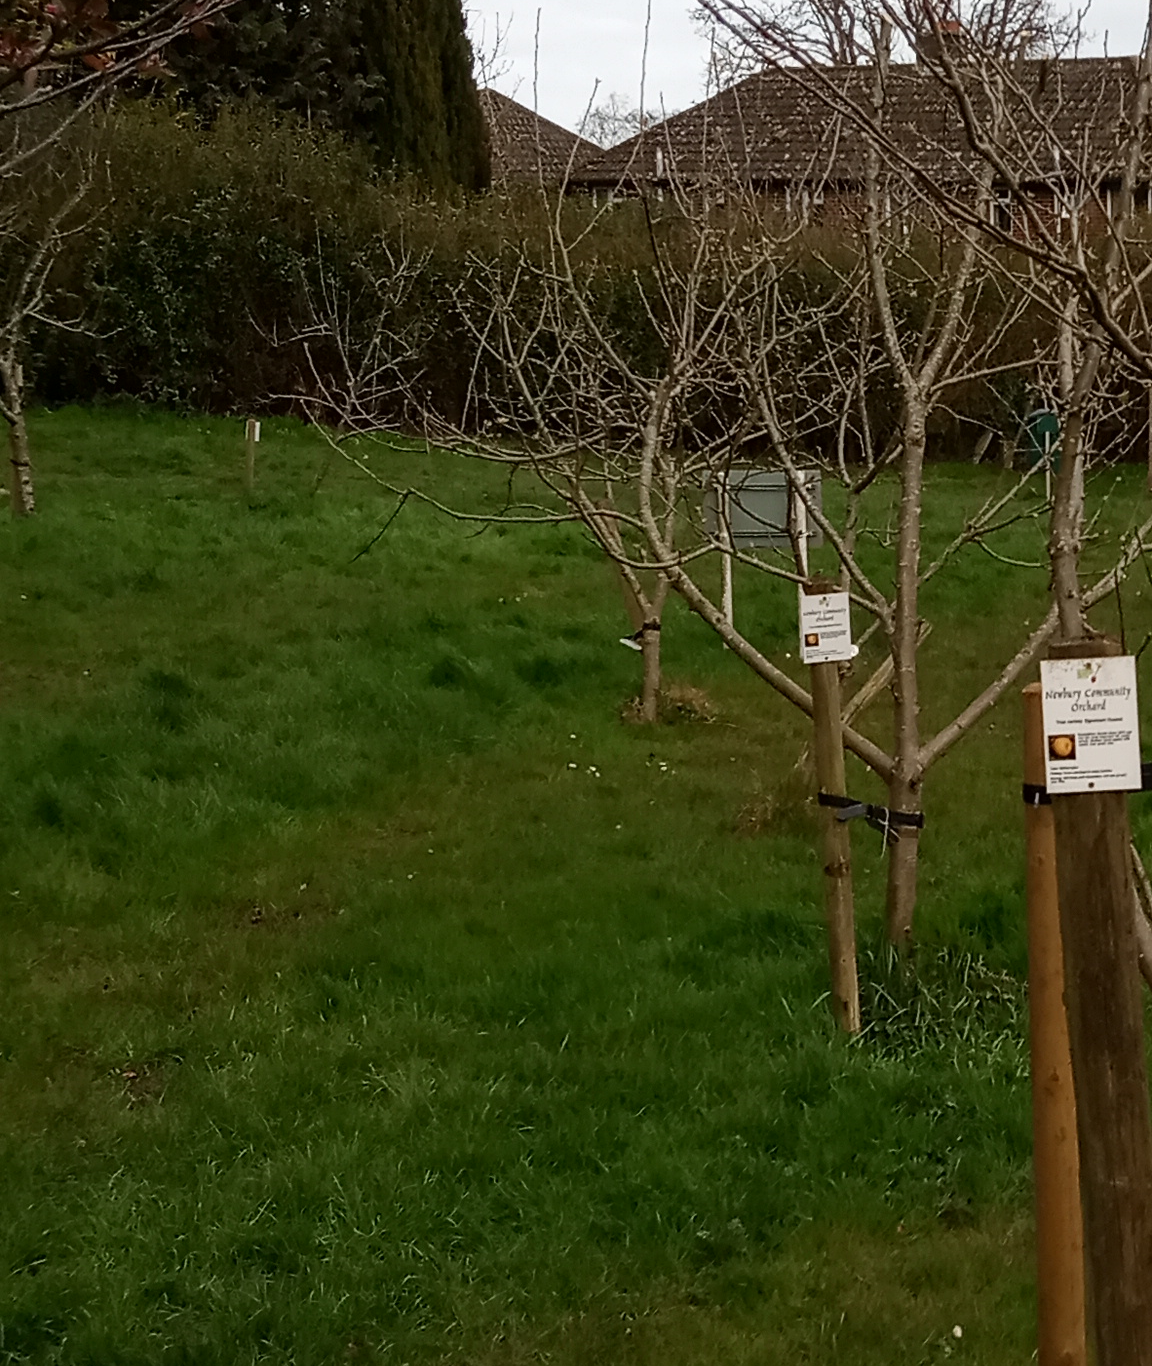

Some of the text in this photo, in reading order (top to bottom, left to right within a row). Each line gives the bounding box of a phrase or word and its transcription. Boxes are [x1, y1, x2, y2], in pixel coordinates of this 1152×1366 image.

[1045, 686, 1131, 702] Newbury Community
[1071, 699, 1107, 712] Orchard
